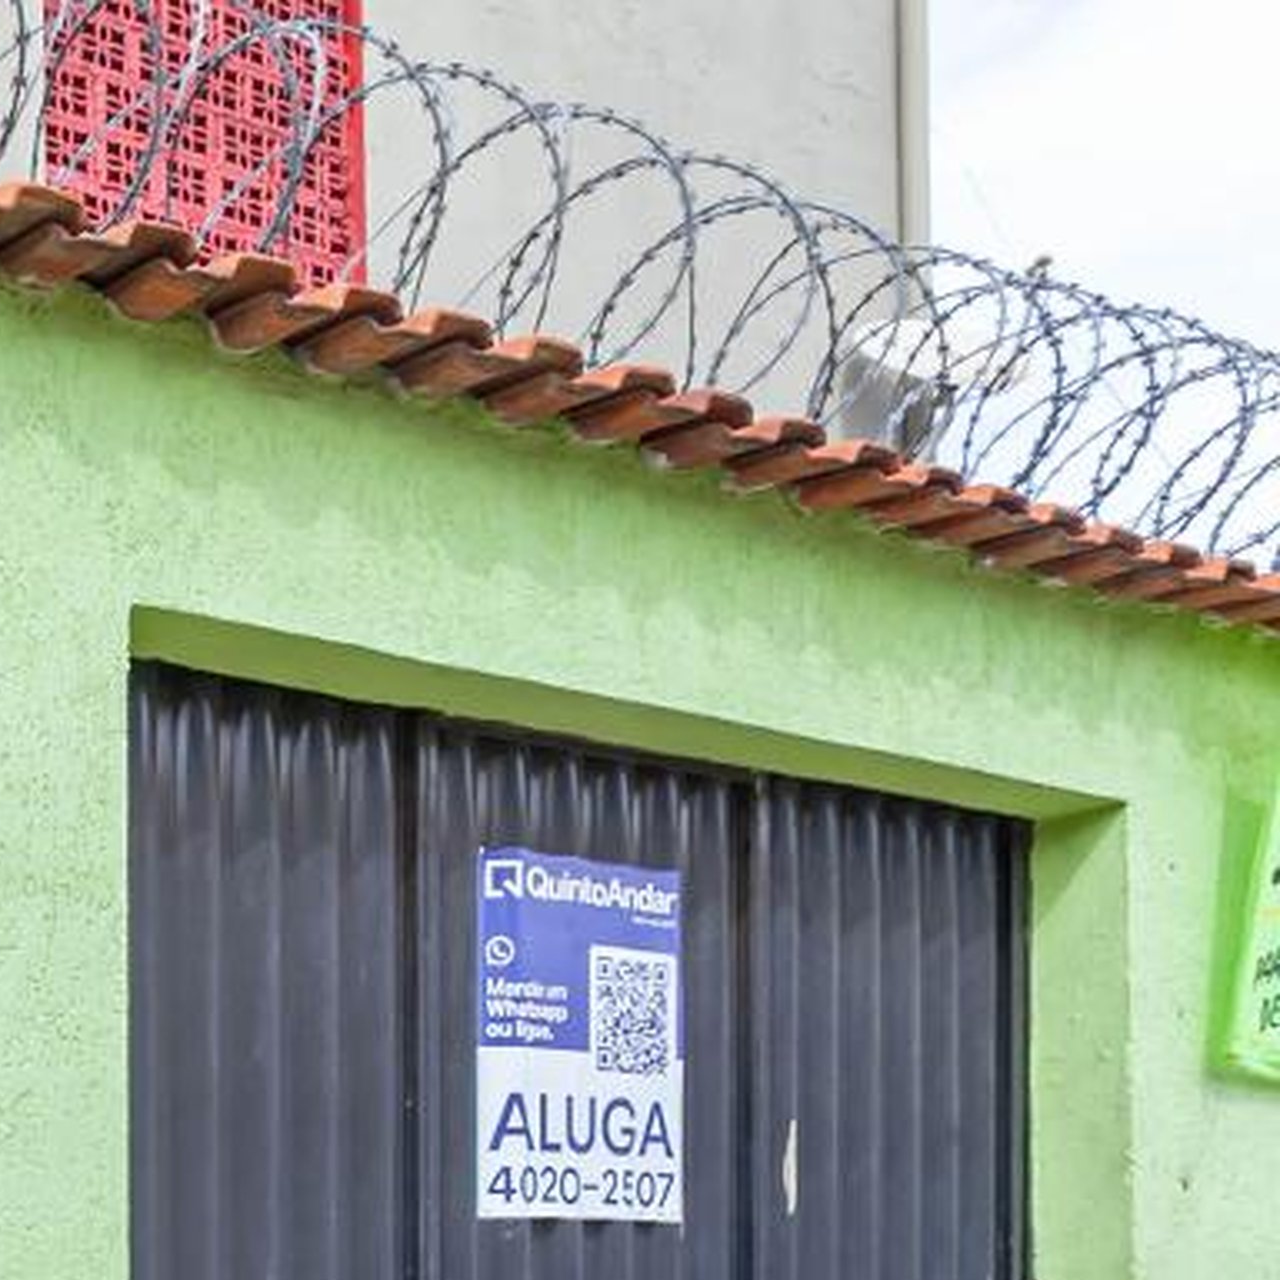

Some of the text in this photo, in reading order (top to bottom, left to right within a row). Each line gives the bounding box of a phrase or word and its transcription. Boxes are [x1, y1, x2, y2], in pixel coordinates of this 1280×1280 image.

[526, 866, 678, 914] QuintoAndar
[486, 1022, 513, 1038] ou
[489, 1092, 674, 1159] ALUGA
[487, 1165, 675, 1208] 4020-2507
